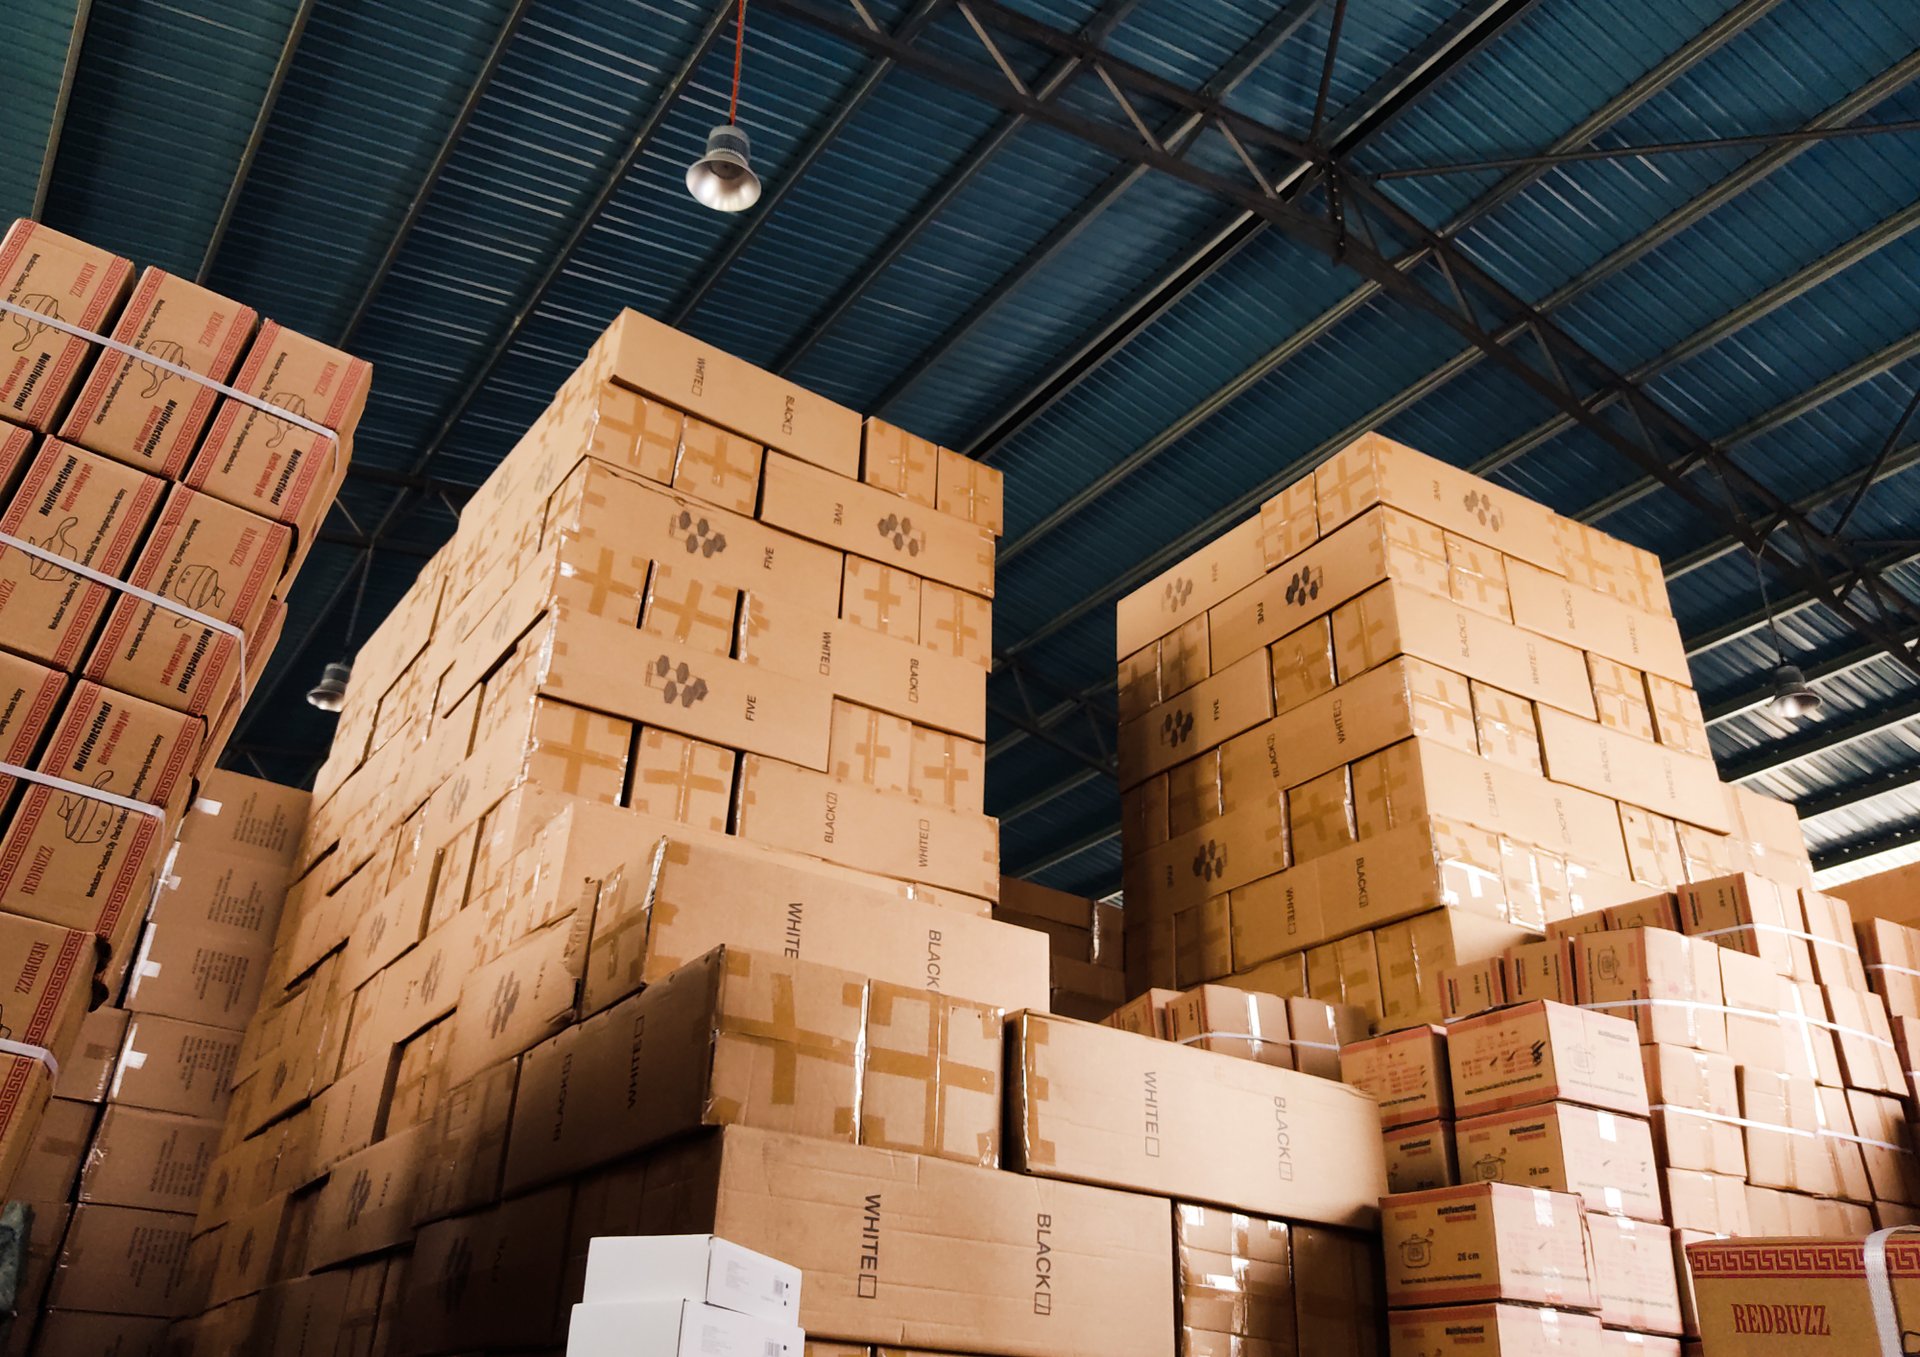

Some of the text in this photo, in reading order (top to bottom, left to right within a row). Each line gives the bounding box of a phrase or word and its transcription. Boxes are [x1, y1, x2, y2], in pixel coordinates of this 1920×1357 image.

[69, 262, 98, 298] REDBUZZ
[13, 352, 51, 411] Multifunctional
[695, 358, 706, 386] WHITE
[142, 399, 178, 458] Multifunctional
[784, 395, 795, 425] BLACK
[38, 455, 78, 517] Multifunctional
[270, 449, 302, 506] Multifunctional
[833, 503, 843, 525] FIVE
[228, 527, 258, 567] REDBUZZ
[763, 546, 775, 570] FIVE
[1256, 601, 1264, 624] FIVE
[176, 628, 214, 694] Multifunctional
[821, 632, 832, 663] WHITE
[909, 658, 919, 689] BLACK
[745, 695, 756, 721] FIVE
[1333, 711, 1345, 744] WHITE
[72, 701, 112, 772] Multifunctional
[1268, 744, 1280, 778] BLACK
[824, 803, 836, 843] BLACK
[918, 831, 929, 868] WHITE
[20, 845, 55, 896] REDBUZZ
[1355, 858, 1367, 896] BLACK
[1285, 887, 1295, 922] WHITE
[784, 902, 803, 959] WHITE
[14, 941, 50, 995] REDBUZZ
[927, 929, 942, 988] BLACK
[1144, 1072, 1158, 1134] WHITE
[1274, 1096, 1291, 1159] BLACK
[861, 1194, 881, 1269] WHITE
[1035, 1214, 1051, 1288] BLACK
[1731, 1304, 1831, 1336] REDBUZZ
